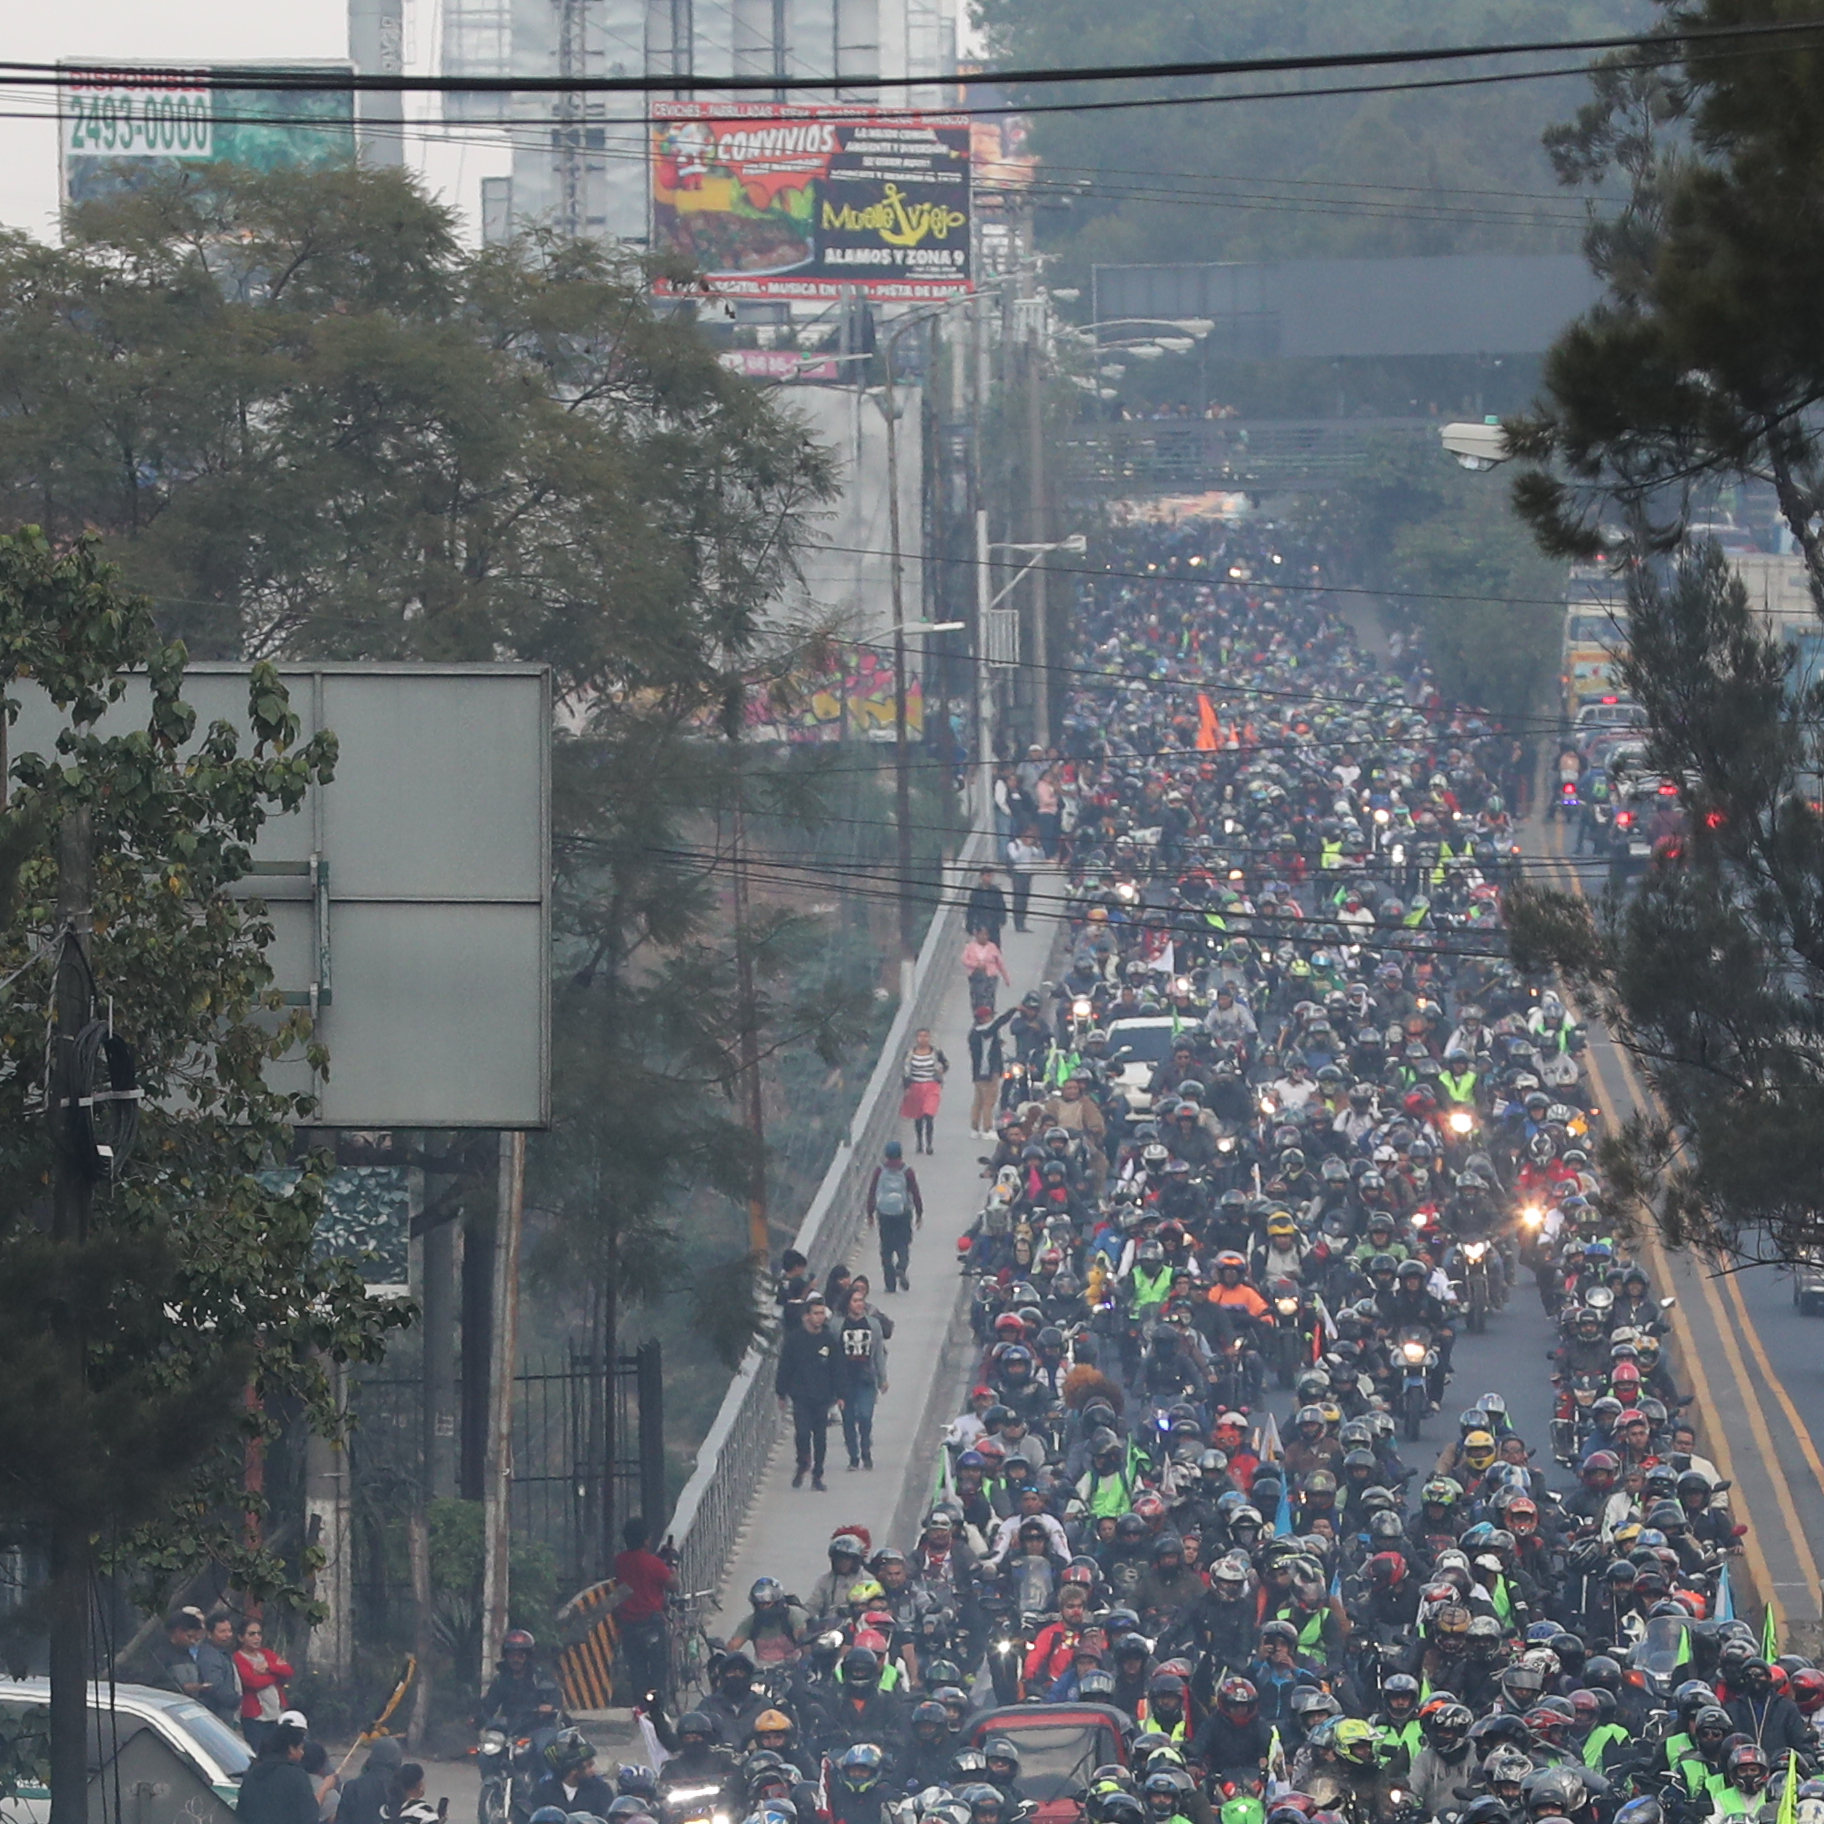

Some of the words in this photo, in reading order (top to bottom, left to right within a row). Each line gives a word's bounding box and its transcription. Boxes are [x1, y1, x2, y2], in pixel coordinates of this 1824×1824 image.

[69, 93, 207, 150] 2493-0000
[717, 123, 835, 162] CONVIVIOS
[825, 248, 892, 265] ALAMOS
[893, 249, 905, 265] Y
[905, 249, 952, 266] ZONA
[952, 249, 965, 266] 9
